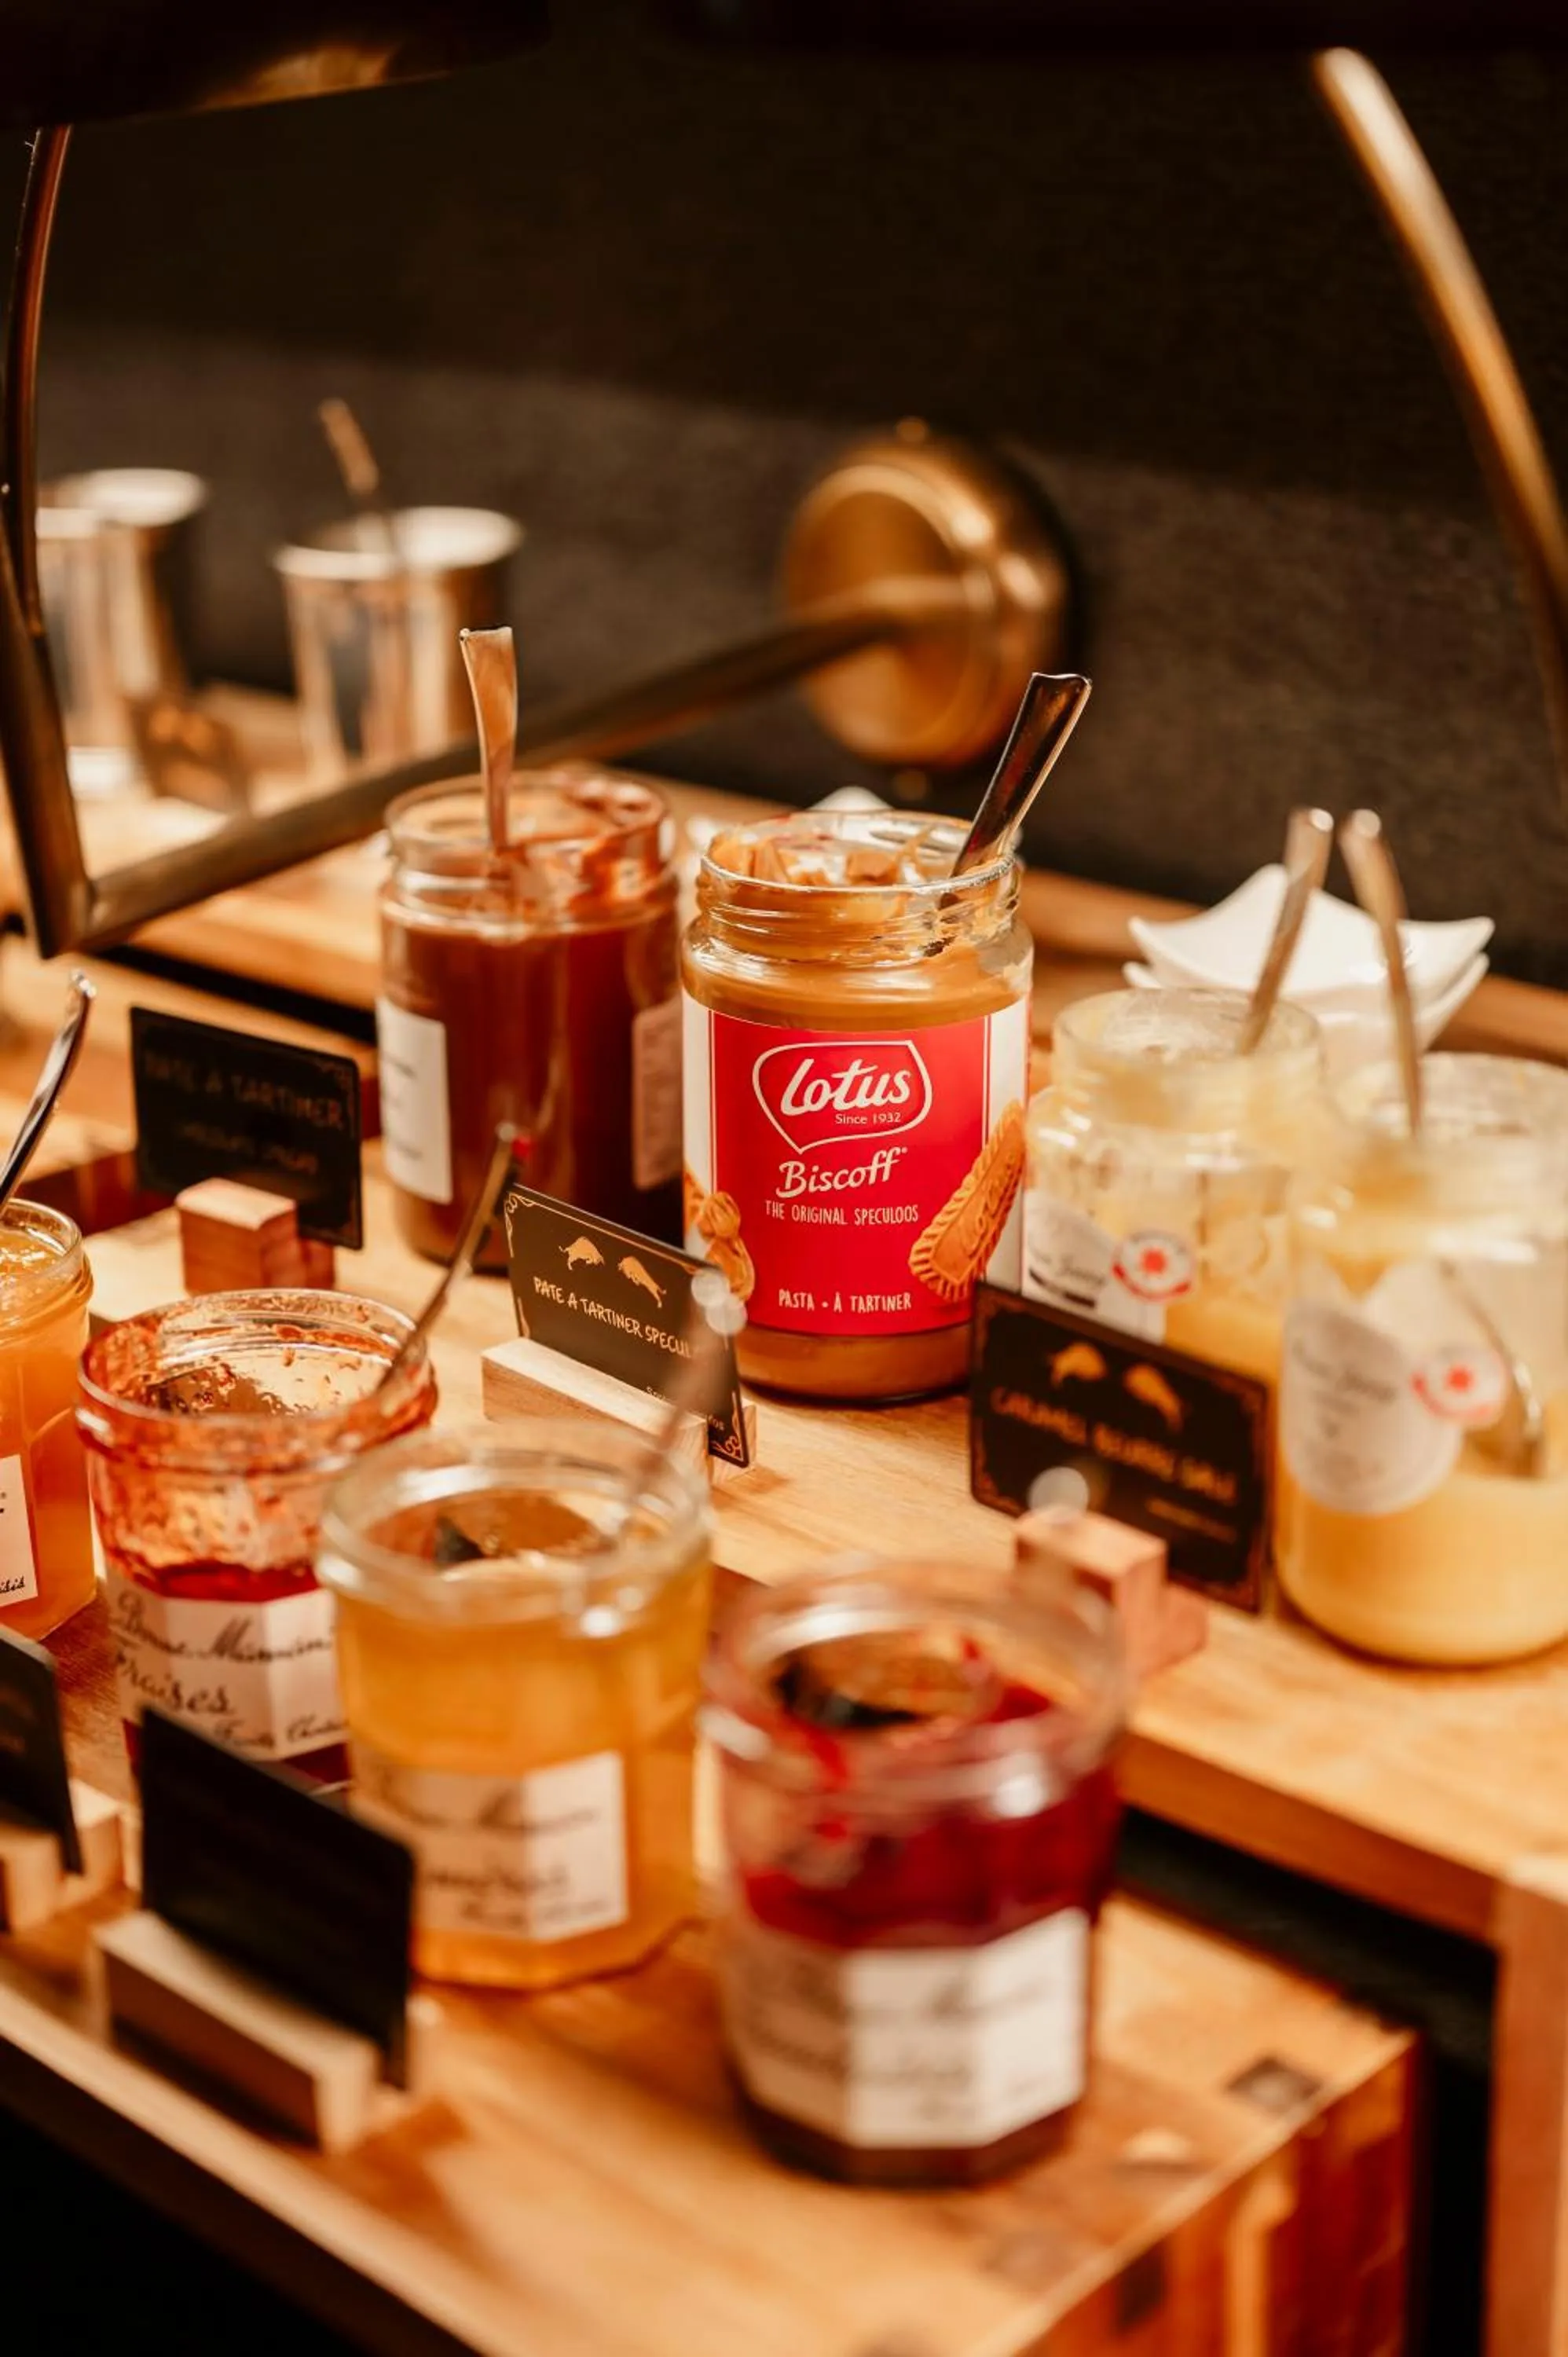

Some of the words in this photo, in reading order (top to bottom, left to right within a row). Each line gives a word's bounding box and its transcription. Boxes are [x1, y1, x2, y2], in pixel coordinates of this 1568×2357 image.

[780, 1058, 912, 1116] Lotus
[835, 1113, 867, 1125] Since
[873, 1112, 901, 1124] 1932
[775, 1146, 901, 1198] Biscoff
[765, 1200, 785, 1220] THE
[791, 1204, 847, 1226] ORIGINAL
[854, 1204, 919, 1226] SPECULOOS
[533, 1276, 564, 1304] PATE
[567, 1292, 578, 1310] A
[580, 1297, 643, 1338] TARTINER
[645, 1324, 696, 1360] SPECUL
[779, 1288, 815, 1312] PASTA
[850, 1292, 912, 1314] TARTINER
